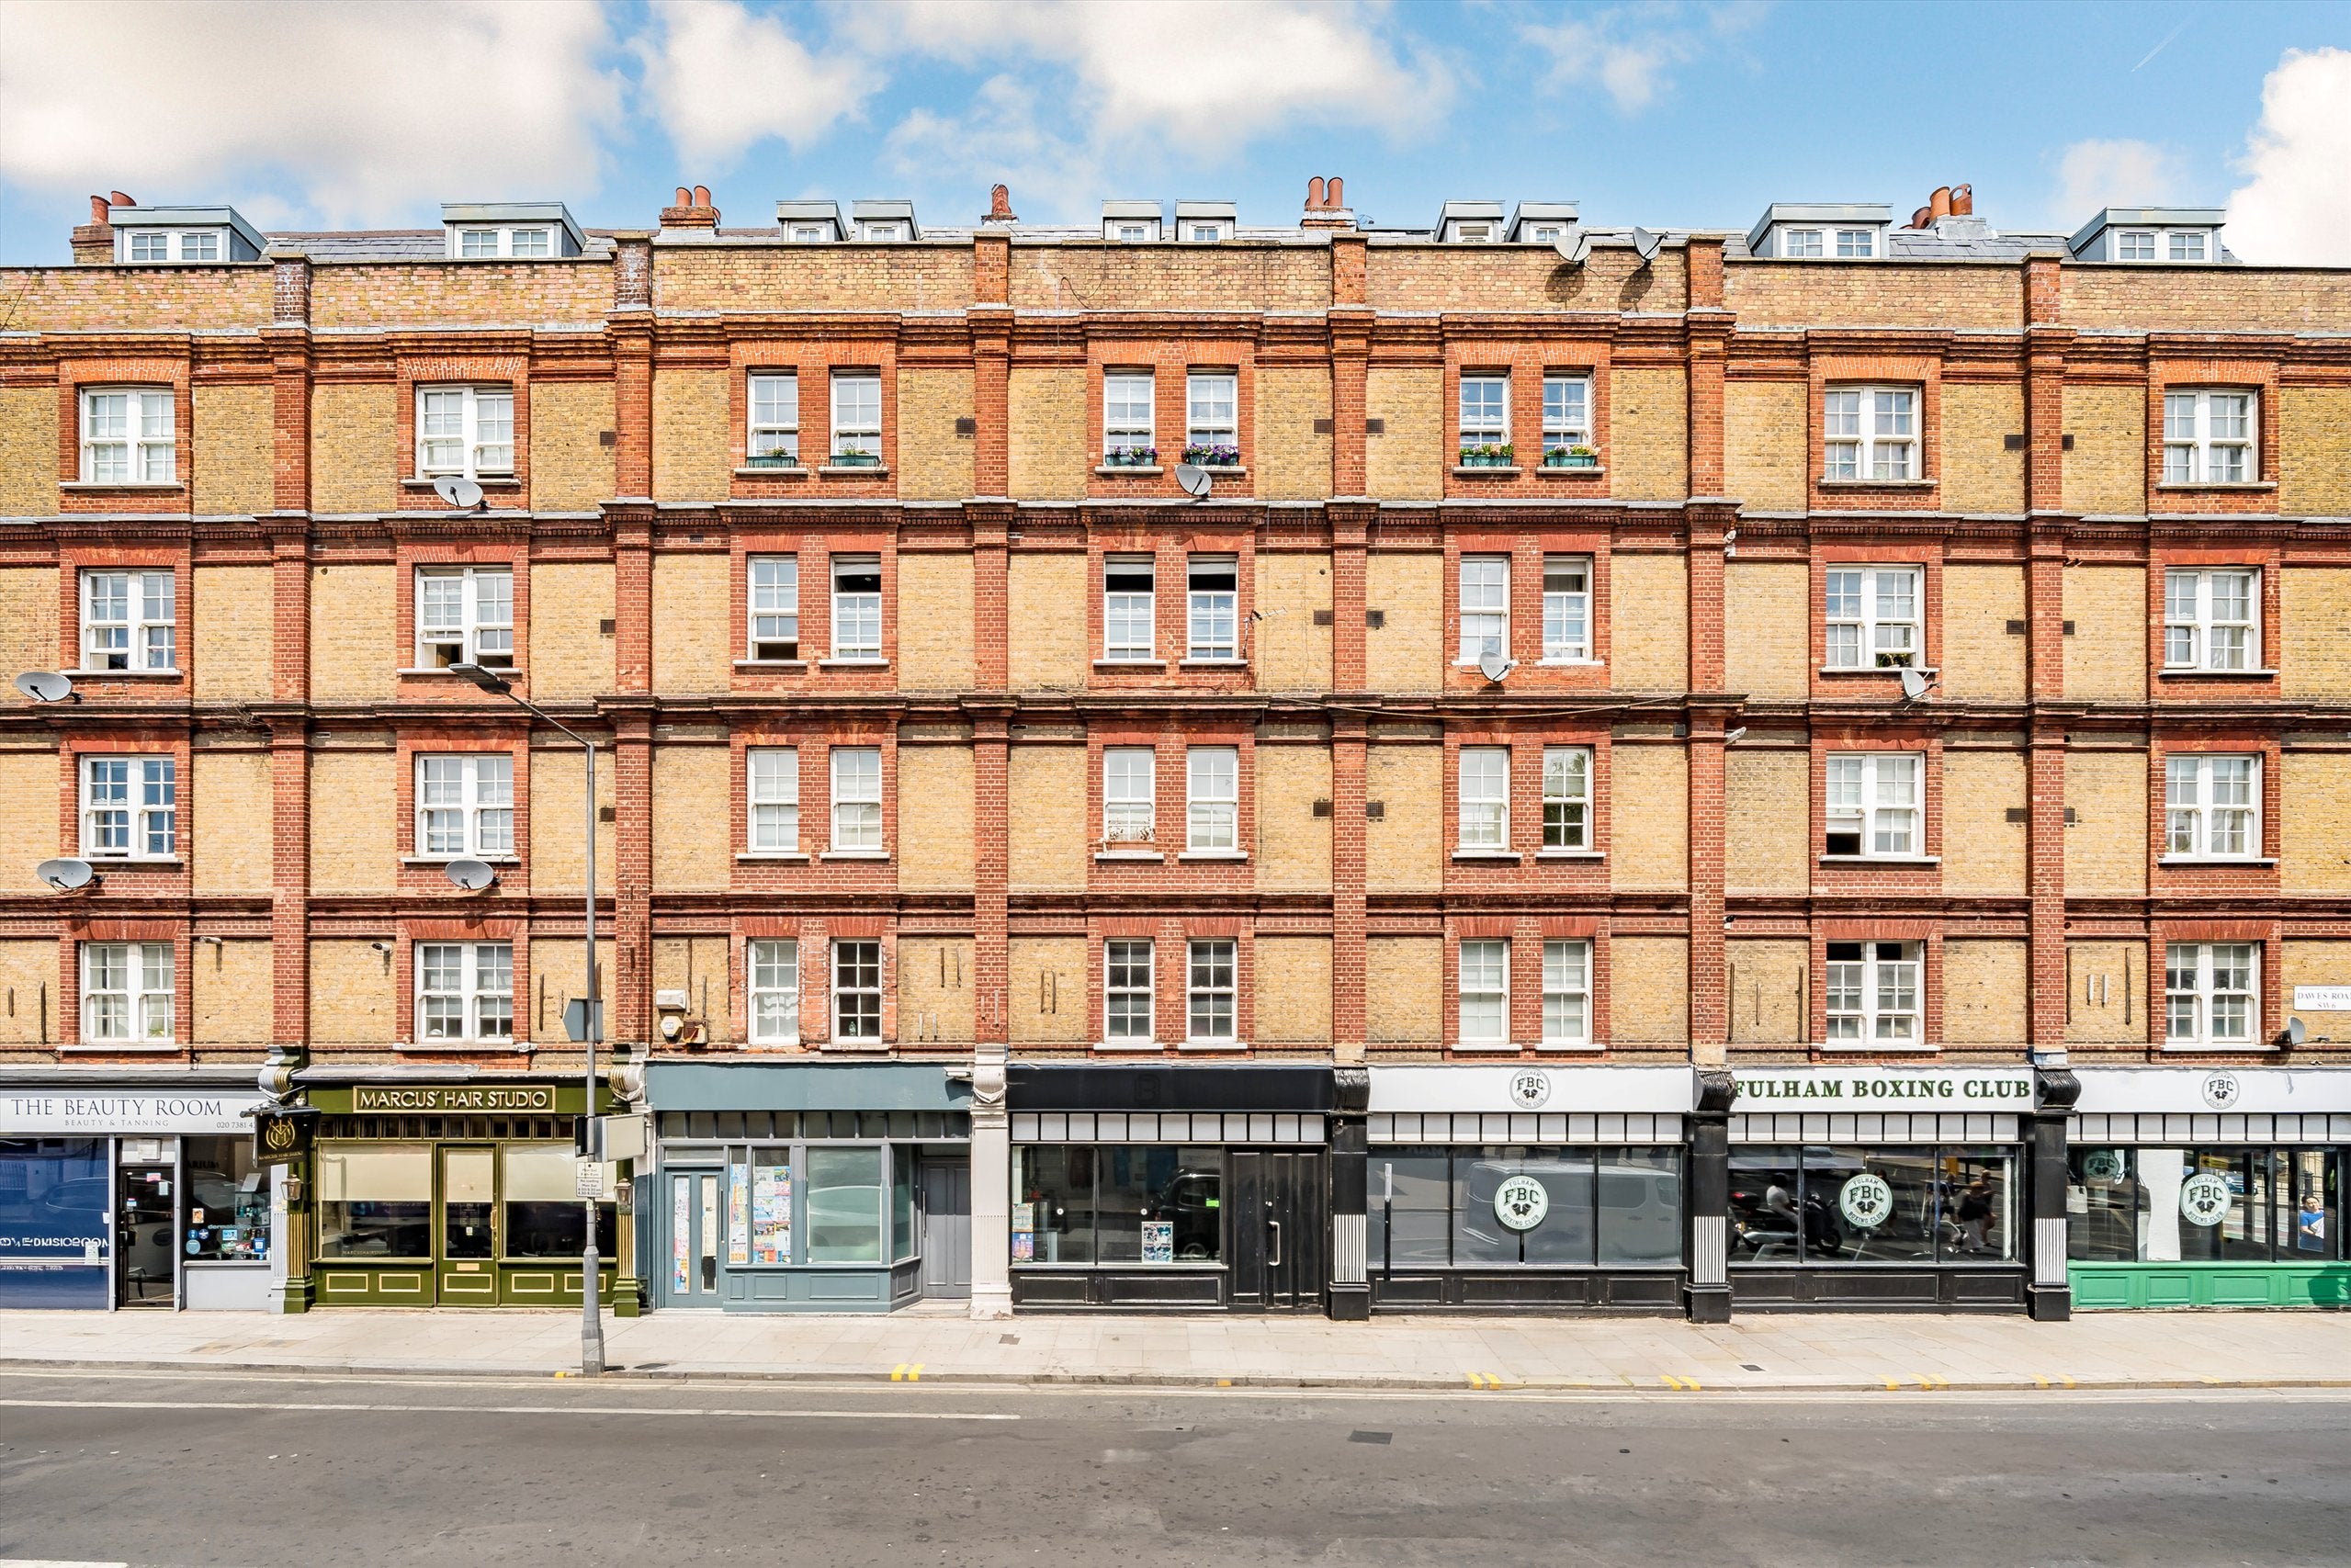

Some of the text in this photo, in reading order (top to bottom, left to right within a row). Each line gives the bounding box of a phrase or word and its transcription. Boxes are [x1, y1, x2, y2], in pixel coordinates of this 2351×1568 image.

[1517, 1077, 1544, 1091] FBC
[1852, 1079, 1954, 1098] BOXING
[1963, 1079, 2030, 1098] CLUB
[2209, 1078, 2233, 1092] FBC
[11, 1099, 222, 1116] THE BEAUTY ROOM
[444, 1091, 483, 1107] HAIR
[487, 1090, 548, 1108] STUDIO
[1853, 1178, 1879, 1186] FULHAM
[1504, 1187, 1540, 1205] FBC
[1848, 1185, 1884, 1204] FBC
[2188, 1185, 2223, 1204] FBC
[1502, 1213, 1541, 1226] BOXING CLUB
[1848, 1211, 1885, 1224] BOXING CLUB
